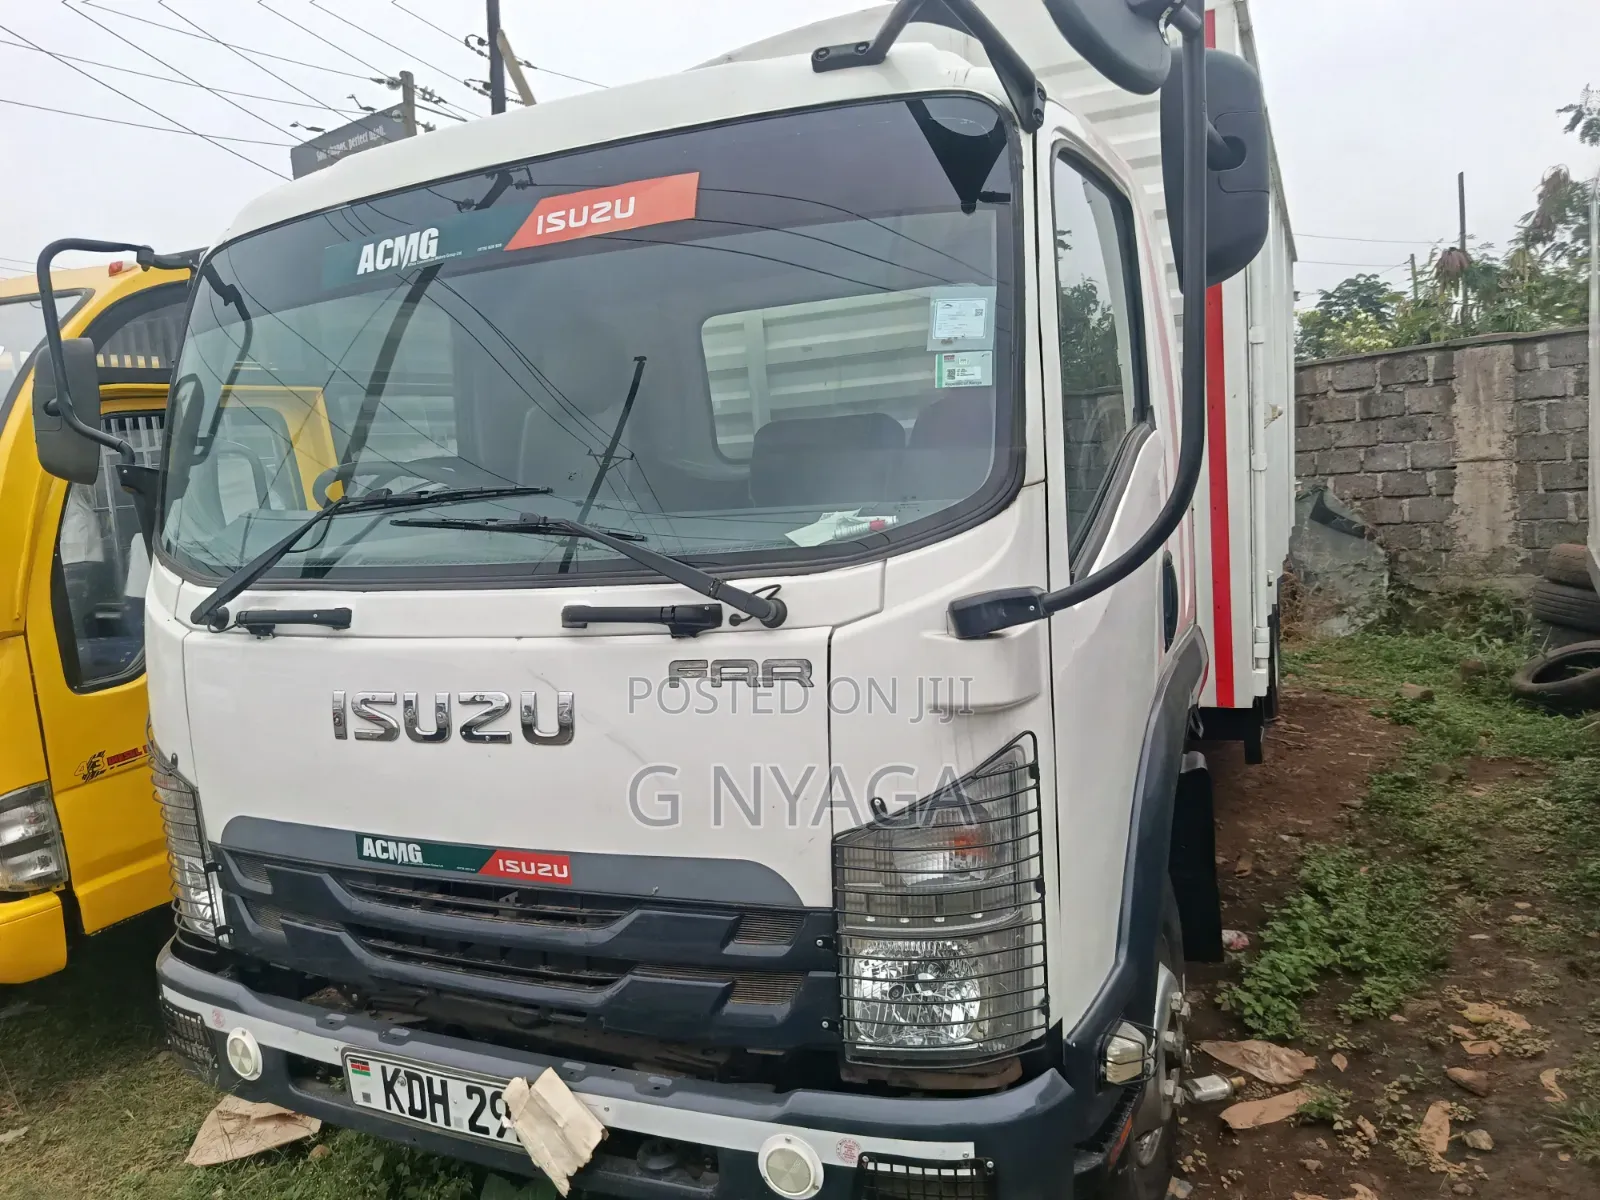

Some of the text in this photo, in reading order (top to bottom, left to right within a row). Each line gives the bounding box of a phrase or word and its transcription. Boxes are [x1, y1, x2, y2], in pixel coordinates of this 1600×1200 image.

[536, 196, 636, 235] ISUZU
[356, 227, 440, 276] ACMG
[332, 690, 576, 746] ISUZU
[362, 837, 569, 878] ACMG ISUZU
[381, 1065, 521, 1143] KDH 29
